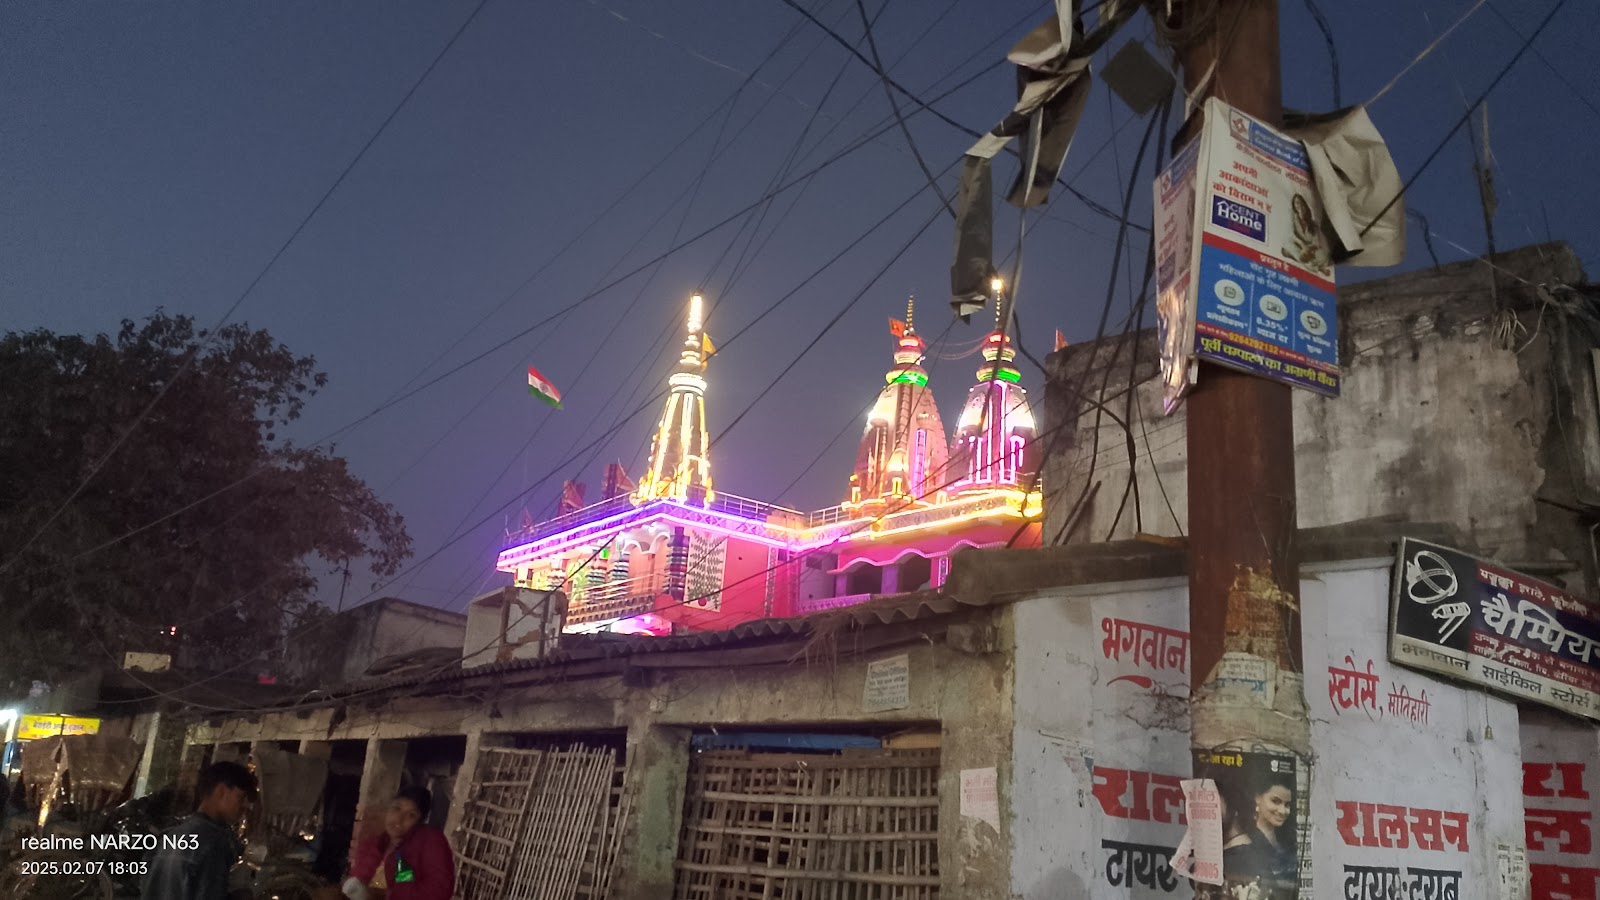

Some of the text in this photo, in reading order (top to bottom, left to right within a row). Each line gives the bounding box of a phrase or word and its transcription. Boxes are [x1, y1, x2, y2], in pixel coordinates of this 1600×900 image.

[1213, 181, 1226, 193] को
[1233, 161, 1258, 179] अपनी
[1217, 204, 1263, 231] Home
[1230, 203, 1260, 220] CENT
[1200, 336, 1222, 354] पूर्वी
[1265, 357, 1282, 371] का
[1317, 371, 1337, 388] बैंक
[1101, 616, 1190, 673] भगवान
[1387, 682, 1432, 726] मोतिहारी
[1401, 642, 1470, 671] भगवान
[1482, 664, 1543, 694] साईकिल
[1550, 687, 1591, 709] स्टोर्स
[1221, 755, 1236, 766] रहा
[1236, 753, 1243, 768] है
[1335, 800, 1470, 853] रालसन
[1101, 838, 1179, 893] टायर
